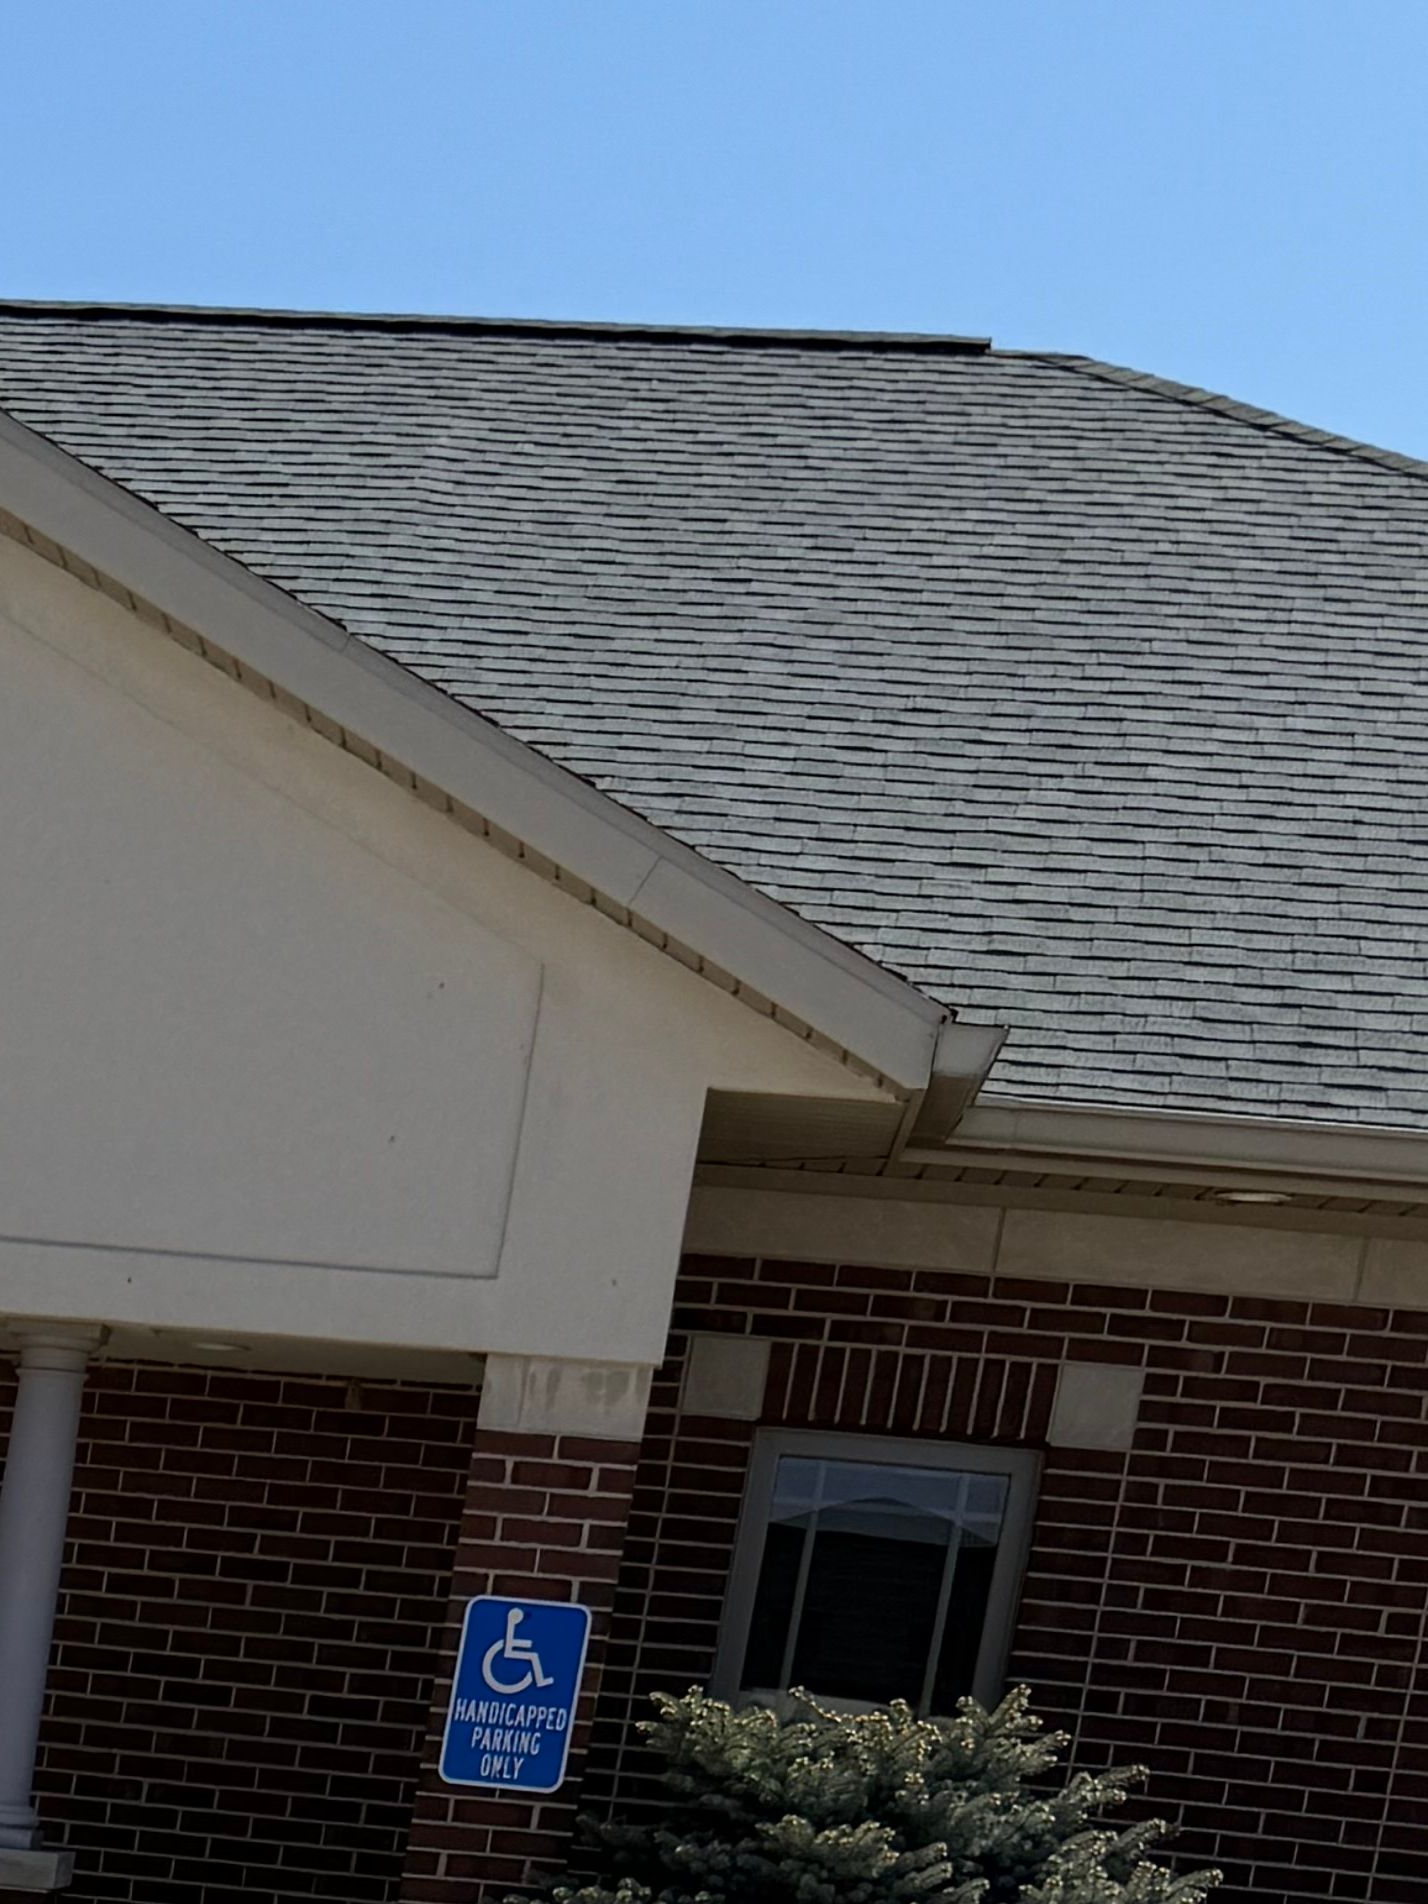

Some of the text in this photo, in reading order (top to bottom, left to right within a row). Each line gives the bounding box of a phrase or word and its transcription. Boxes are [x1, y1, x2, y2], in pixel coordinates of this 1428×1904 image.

[454, 1697, 567, 1732] HANDICAPPED
[471, 1726, 542, 1756] PARKING
[479, 1754, 525, 1780] ONLY
